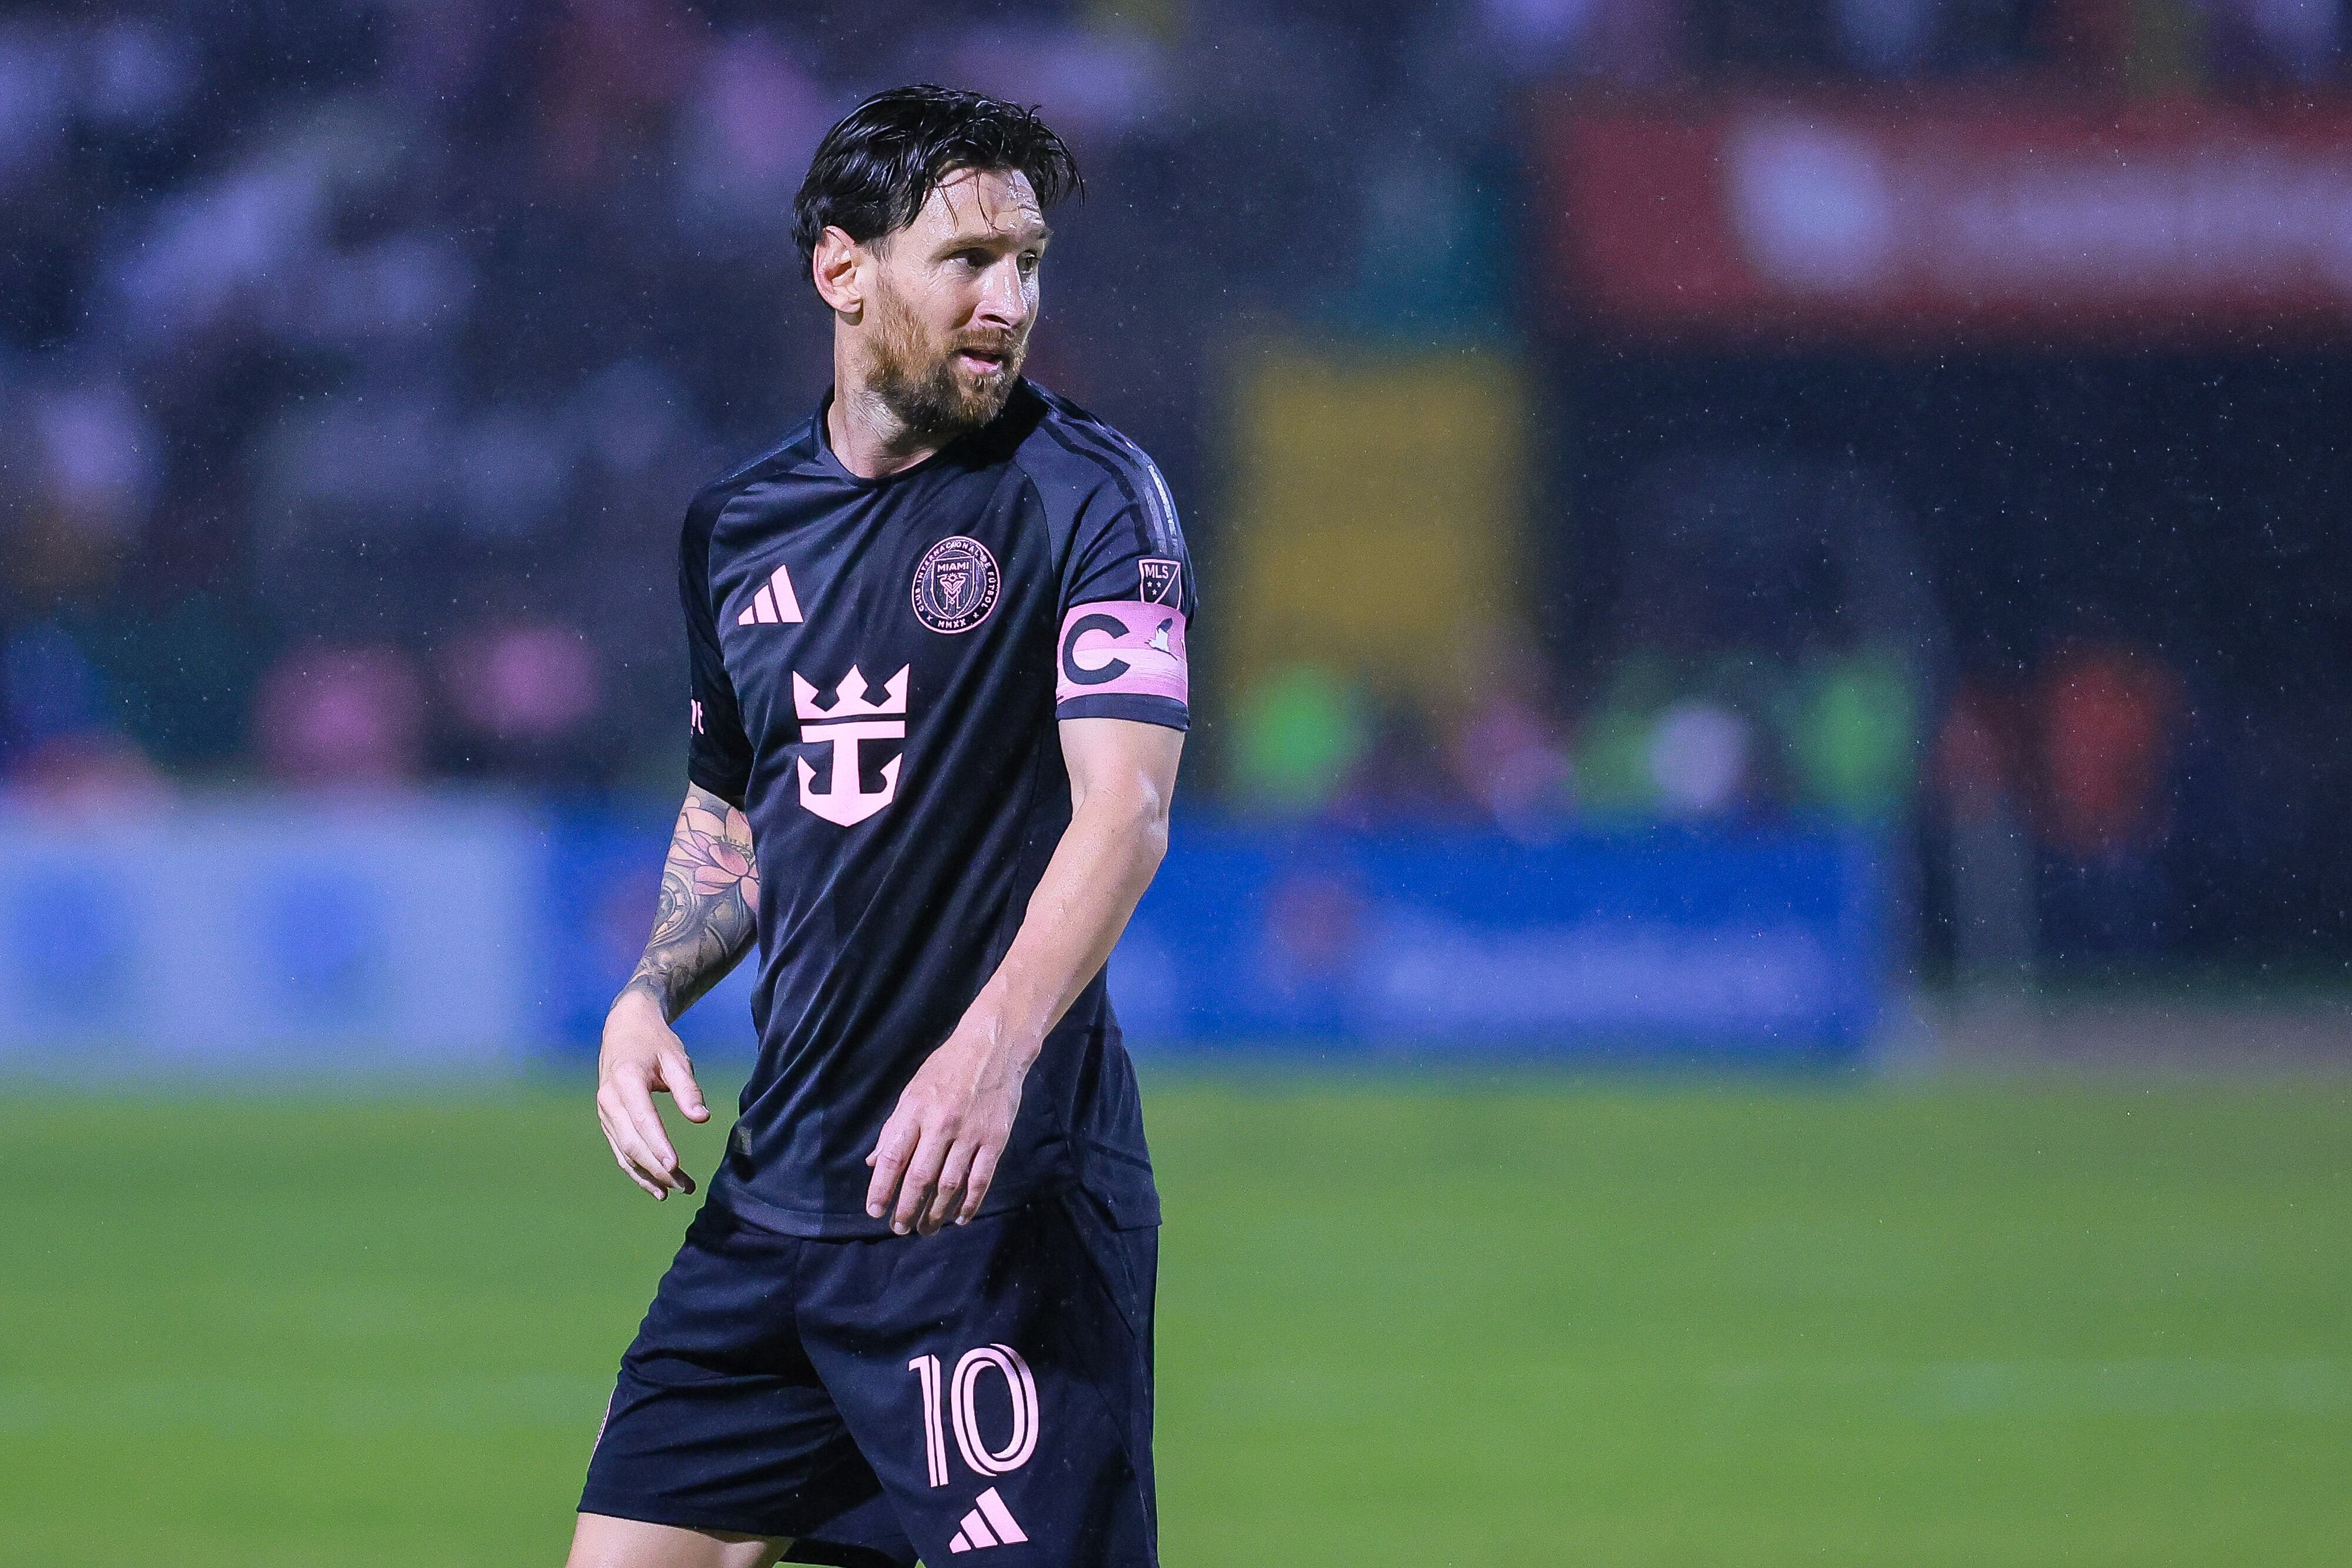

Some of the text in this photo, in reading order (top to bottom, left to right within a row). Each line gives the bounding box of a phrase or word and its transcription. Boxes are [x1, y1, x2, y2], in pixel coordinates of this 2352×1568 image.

[916, 541, 979, 583] INTERNACIONAL
[937, 561, 970, 573] MIAMI
[980, 554, 992, 569] DE
[1144, 564, 1169, 579] MLS
[915, 588, 924, 612] CLUB
[937, 619, 967, 628] MMXX
[1063, 613, 1131, 686] C
[908, 1343, 1040, 1488] 10
